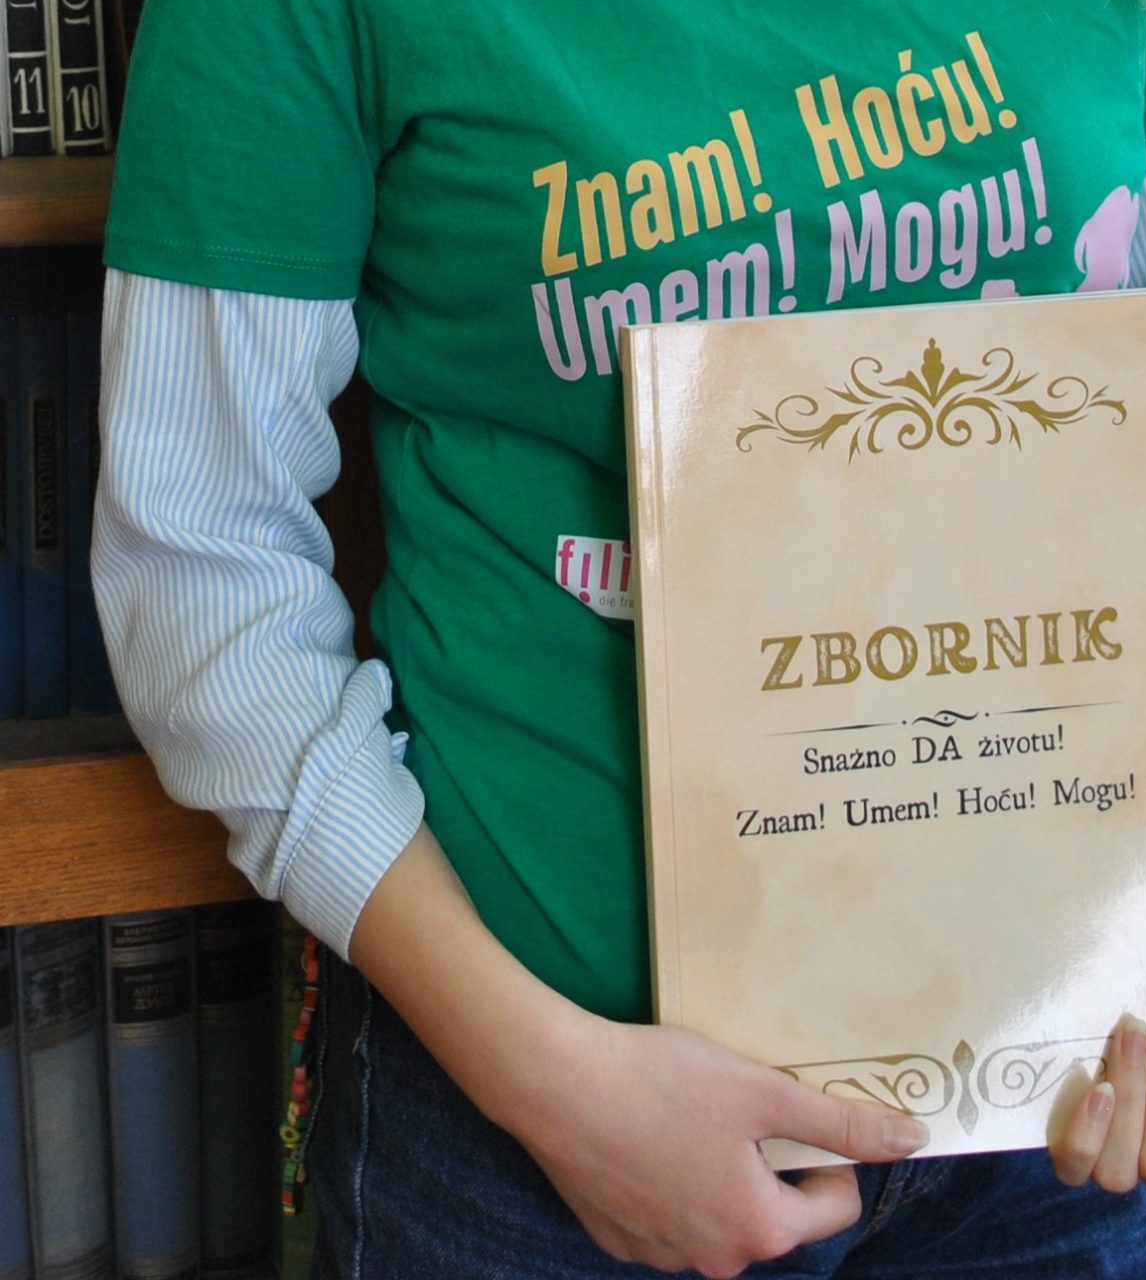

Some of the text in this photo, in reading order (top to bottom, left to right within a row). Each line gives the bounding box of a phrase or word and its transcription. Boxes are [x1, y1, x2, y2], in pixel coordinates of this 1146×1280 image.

[13, 66, 44, 115] 11
[65, 82, 100, 132] 10
[532, 31, 1017, 277] Znam! Hoću!
[825, 137, 1053, 306] Mogu!
[760, 606, 1123, 691] ZBORNIK
[803, 724, 1064, 775] Snažno DA životu!
[736, 773, 1136, 837] Znam! Umem! Hoću! Mogu!
